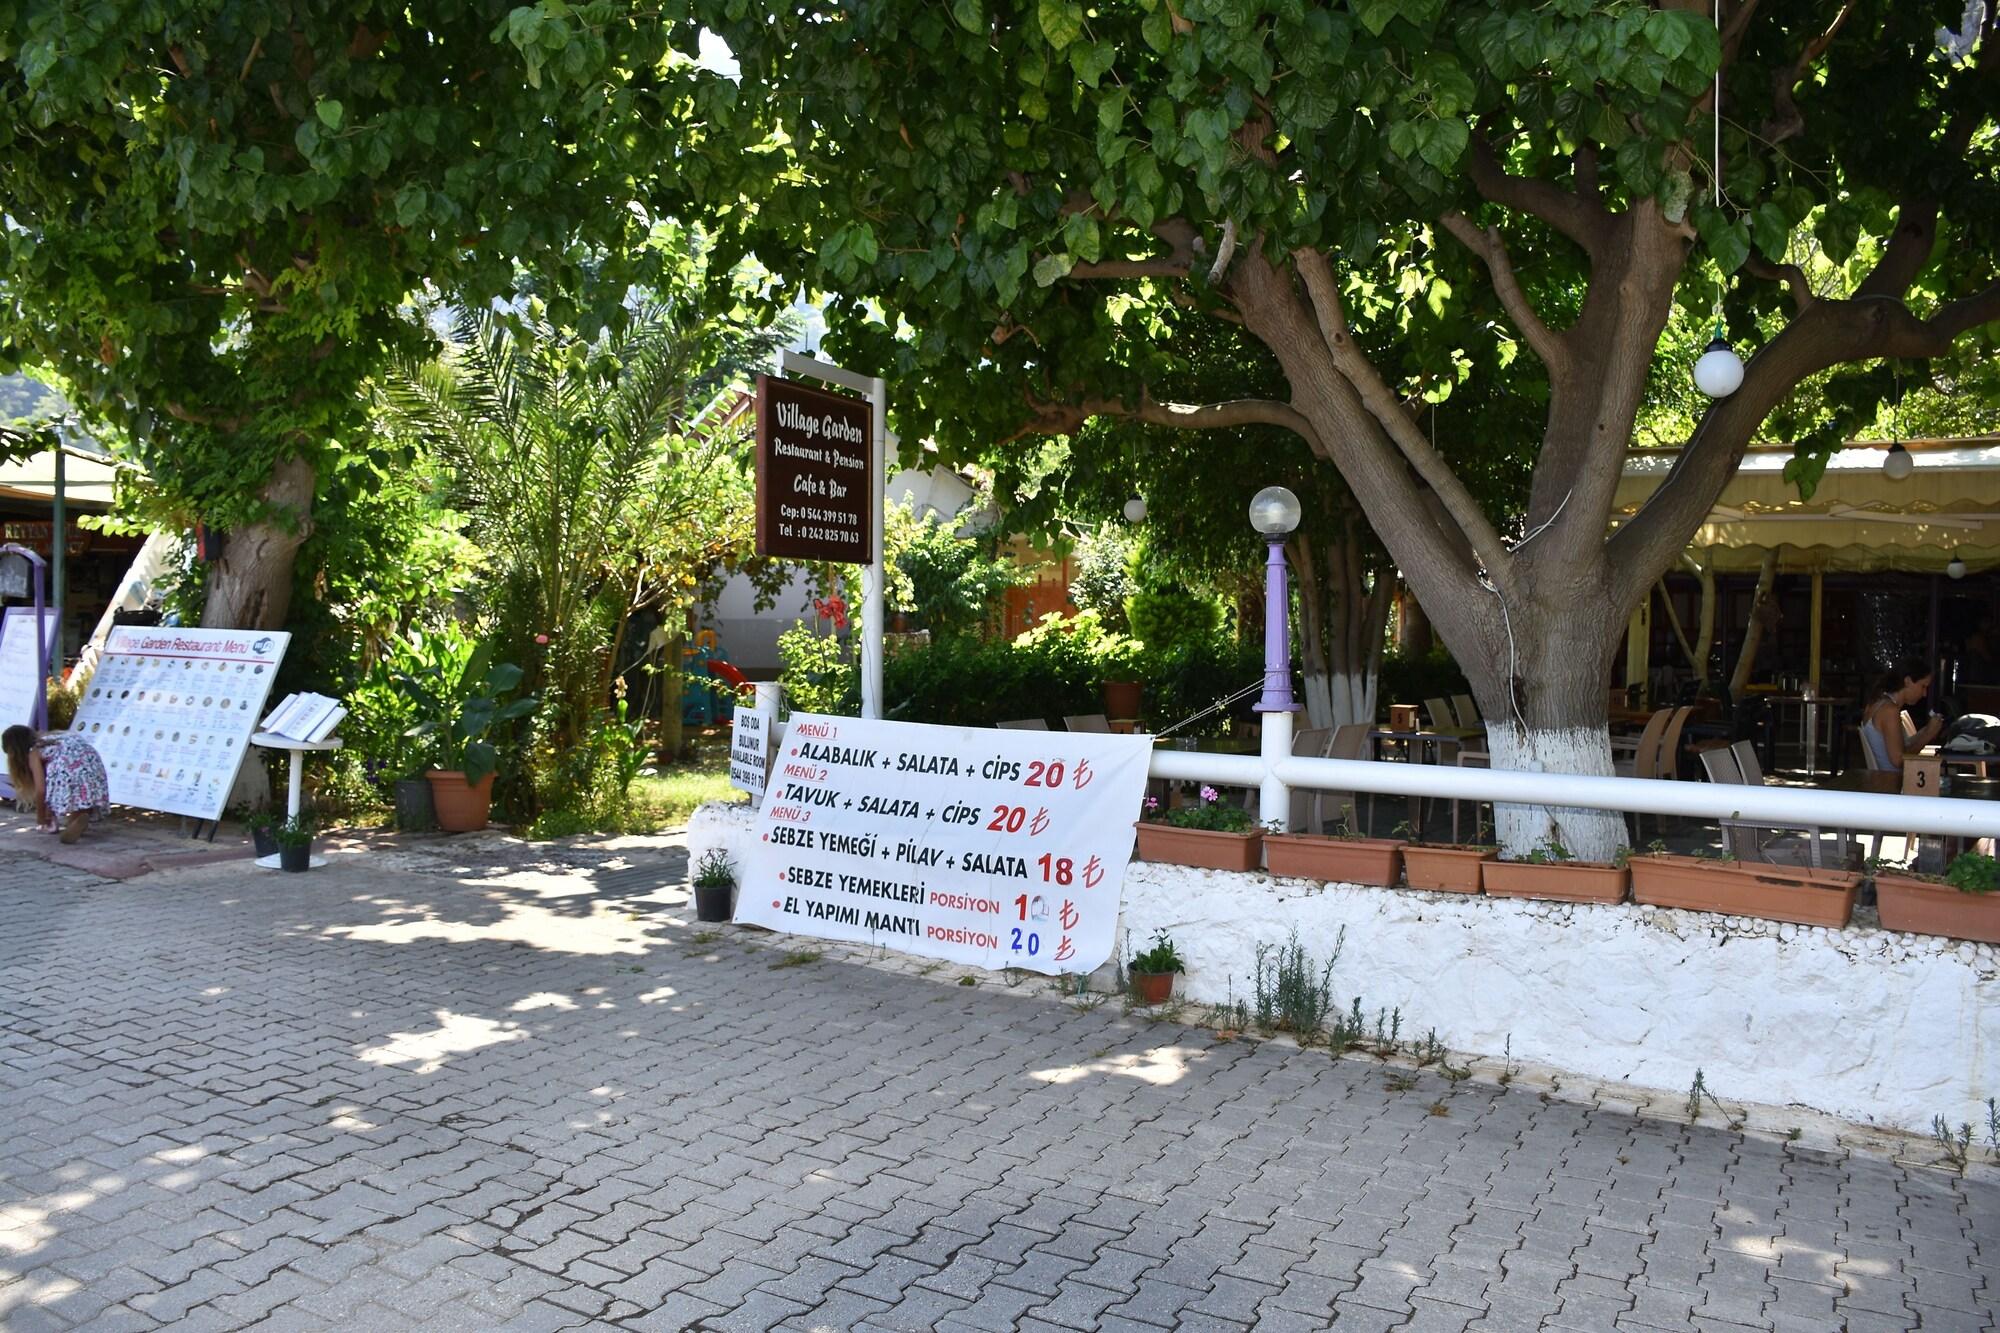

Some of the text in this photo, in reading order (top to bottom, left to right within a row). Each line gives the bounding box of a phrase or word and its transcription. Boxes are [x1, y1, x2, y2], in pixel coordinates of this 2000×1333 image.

[775, 402, 862, 444] Village Garden
[774, 437, 864, 470] Restaurant & Pension
[794, 473, 847, 499] Cafe & Bar
[781, 504, 857, 525] Cep: 0 544 399 51 78
[779, 523, 793, 537] Tel
[808, 526, 823, 540] 242
[824, 528, 839, 542] 825
[840, 530, 849, 542] 70
[850, 532, 859, 544] 63
[141, 636, 173, 650] Garden
[797, 722, 839, 738] MENÜ 1
[784, 763, 828, 781] MENÜ 2
[799, 742, 877, 768] ALABALIK
[897, 753, 959, 776] SALATA
[982, 755, 1021, 781] CİPS
[1024, 761, 1065, 788] 20
[1917, 770, 1926, 788] 3
[770, 805, 812, 822] MENÜ 3
[785, 784, 840, 808] TAVUK
[858, 795, 920, 818] SALATA
[942, 800, 981, 826] CİPS
[987, 805, 1026, 833] 20
[771, 826, 814, 846] SEBZE
[820, 832, 878, 858] YEMEĞİ
[896, 838, 943, 867] PİLAV
[962, 852, 1028, 879] SALATA
[1038, 853, 1073, 885] 18
[788, 866, 833, 889] SEBZE
[839, 874, 925, 905] YEMEKLERİ
[930, 892, 1000, 914] PORSİYON
[783, 897, 799, 915] EL
[805, 900, 859, 926] YAPIMI
[864, 911, 920, 936] MANTI
[927, 926, 998, 949] PORSİYON
[1011, 928, 1040, 956] 20
